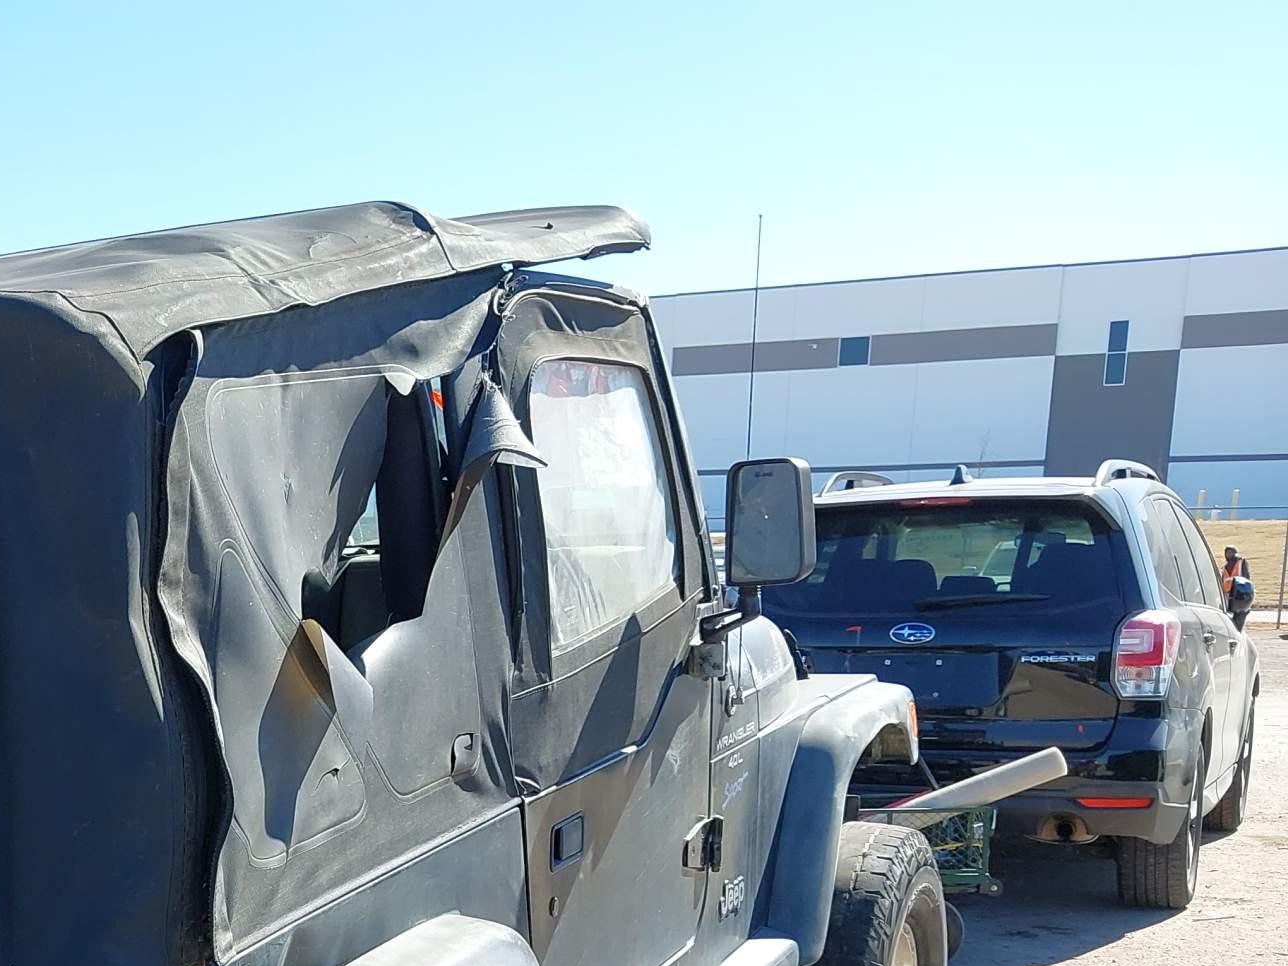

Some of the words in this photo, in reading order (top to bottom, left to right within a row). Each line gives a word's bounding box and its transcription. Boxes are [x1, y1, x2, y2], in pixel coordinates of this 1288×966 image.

[1020, 654, 1096, 663] FORESTER
[716, 720, 755, 751] WRANGLER
[720, 875, 745, 918] Jeep
